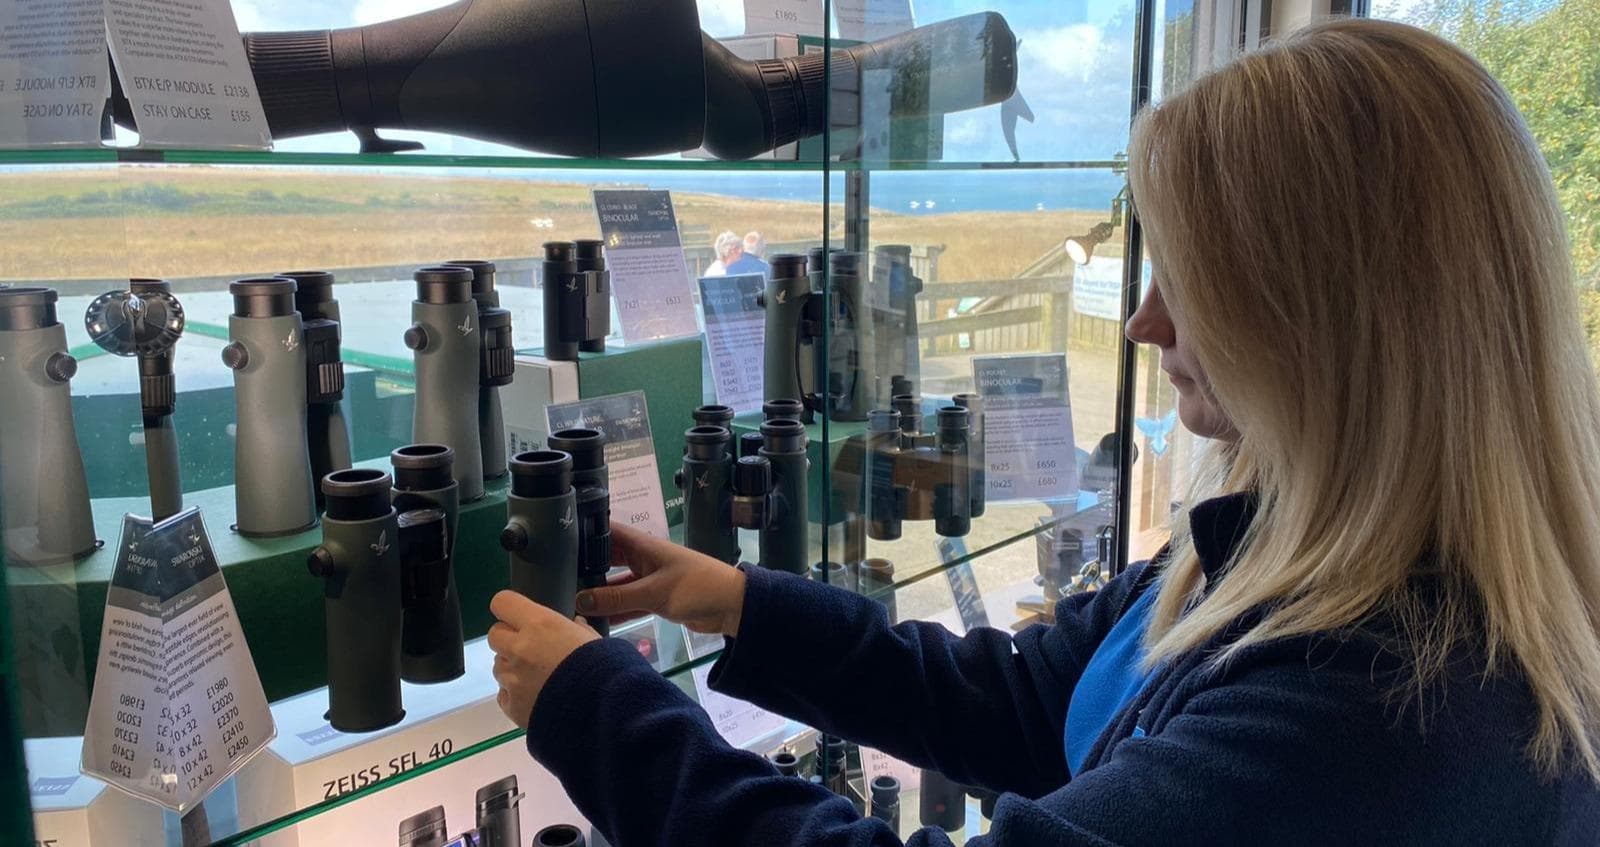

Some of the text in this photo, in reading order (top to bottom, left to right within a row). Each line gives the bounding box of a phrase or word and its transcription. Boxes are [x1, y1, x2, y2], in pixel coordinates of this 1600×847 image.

[134, 76, 155, 90] BTX
[174, 80, 216, 95] MODULE
[223, 85, 249, 98] £2138
[143, 104, 168, 118] STAY
[170, 106, 186, 118] ON
[187, 107, 214, 120] CASE
[630, 511, 650, 525] £950
[206, 677, 229, 699] £1980
[211, 692, 234, 714] £2020
[217, 706, 239, 729] £2370
[181, 761, 192, 776] 10
[222, 721, 245, 744] £2410
[226, 735, 249, 759] £2450
[323, 738, 453, 800] ZEISS SFL 40
